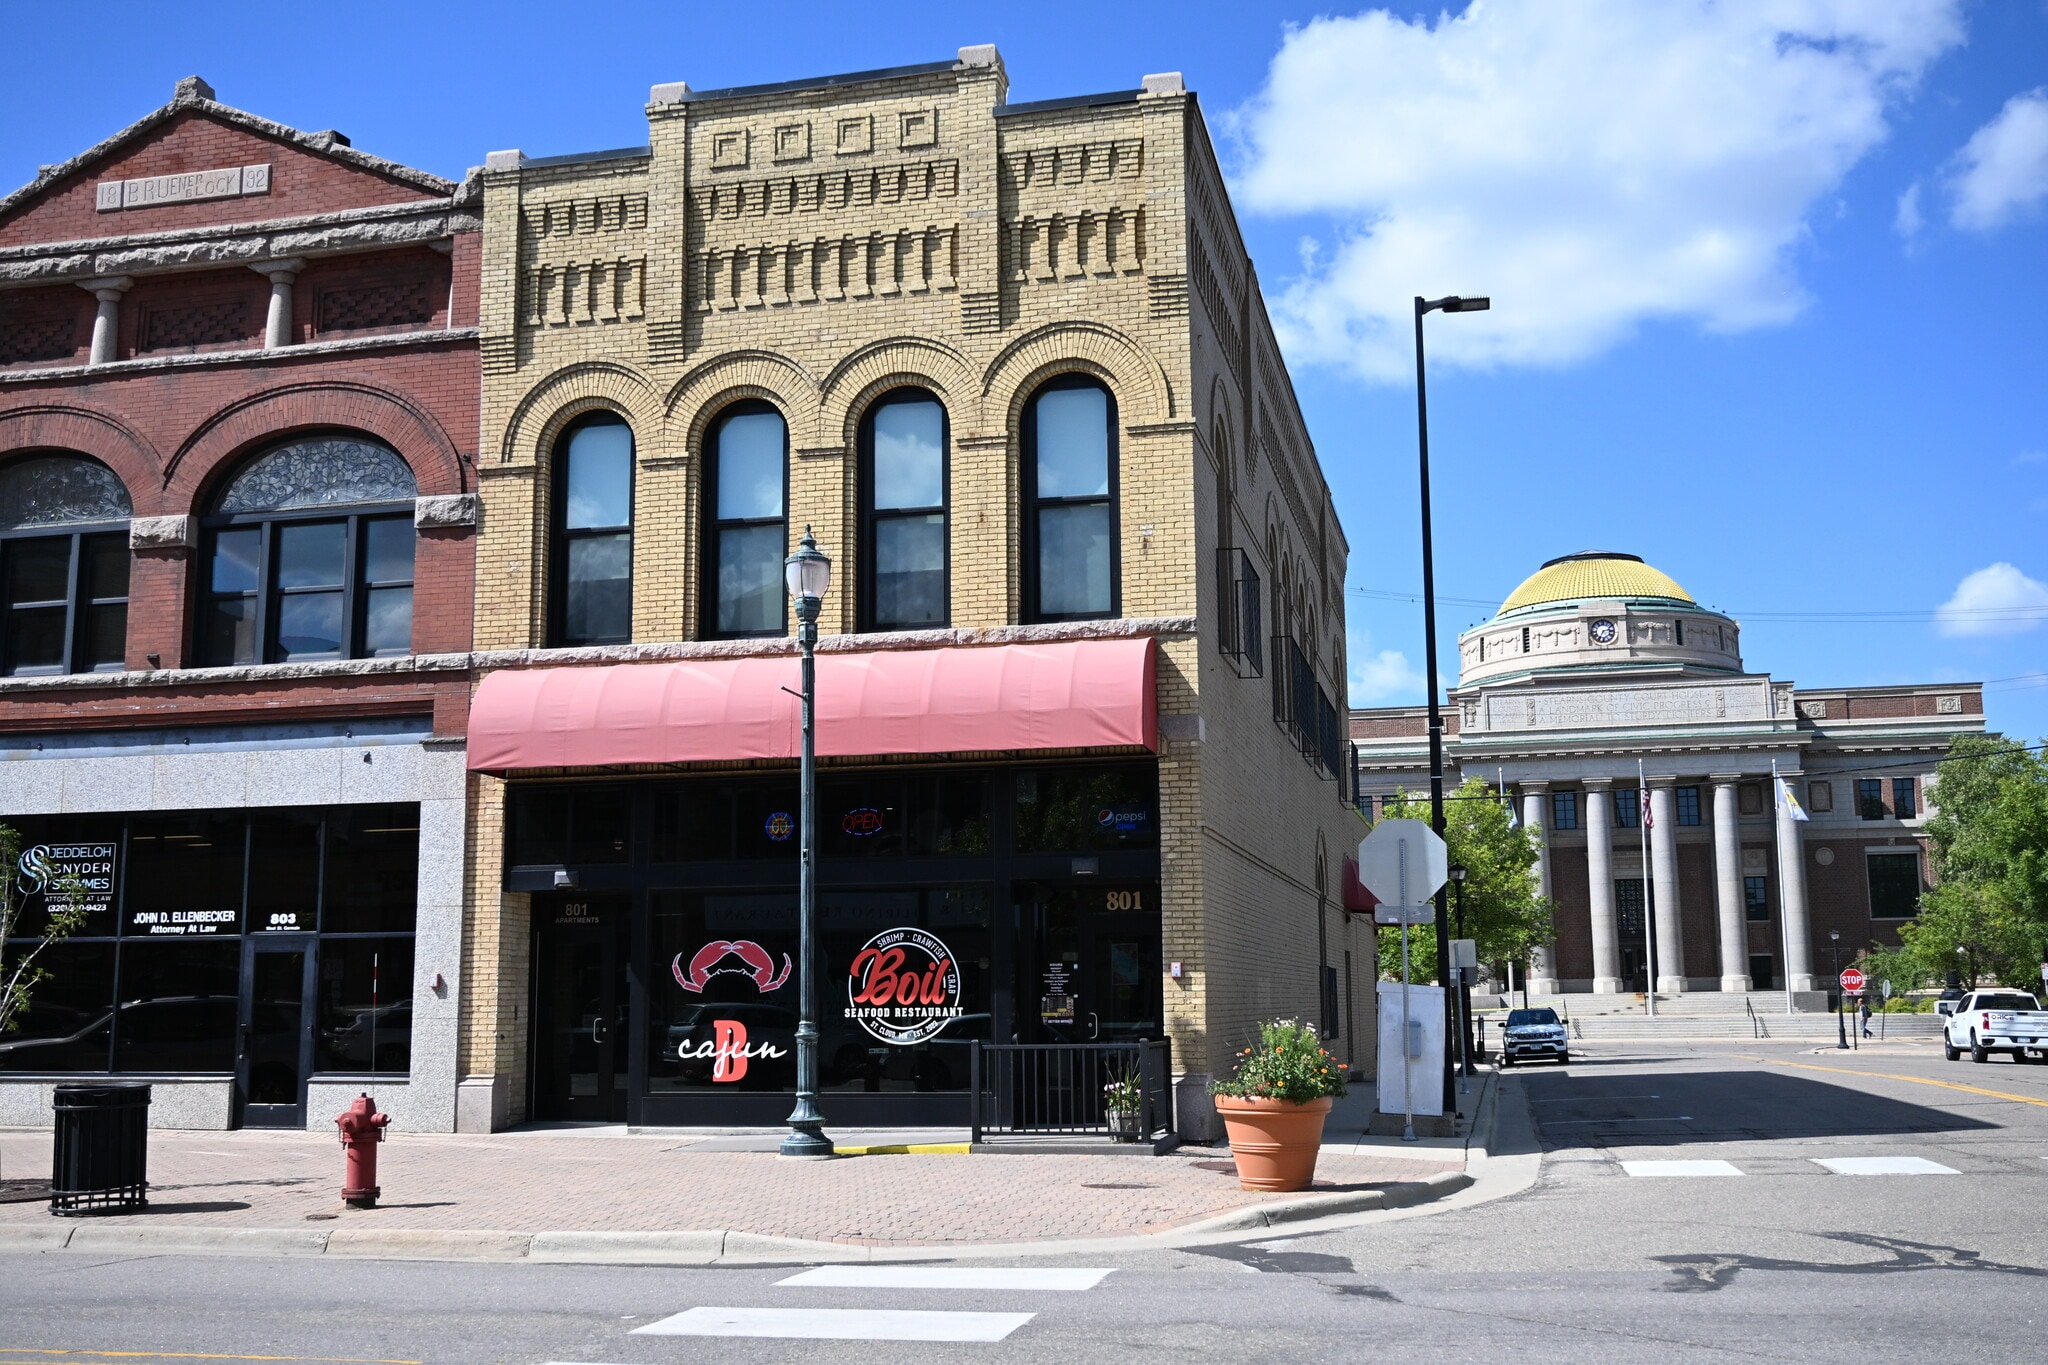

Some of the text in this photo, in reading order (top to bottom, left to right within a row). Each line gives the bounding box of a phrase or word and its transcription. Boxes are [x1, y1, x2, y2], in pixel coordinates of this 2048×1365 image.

[101, 169, 268, 205] 18 BRUENER BLOCK 92
[1544, 690, 1704, 705] STEARNS COUNTY COURT HOUSE
[1549, 704, 1603, 714] LANDMARK
[1607, 703, 1619, 712] OF
[1622, 702, 1650, 711] CIVIC
[1654, 700, 1703, 709] PROGRESS
[1549, 714, 1599, 723] MEMORIAL
[1607, 713, 1620, 721] TO
[1624, 711, 1661, 720] STURDY
[1666, 709, 1711, 719] PIONEERS
[842, 811, 884, 830] OPEN
[1115, 811, 1146, 823] pepsi
[49, 846, 112, 858] JEDDELOH
[53, 862, 111, 874] SNYDER
[1106, 891, 1142, 911] 801
[565, 903, 587, 916] 801
[134, 910, 236, 924] JOHN D. ELLENBECKER
[270, 913, 296, 925] 803
[555, 916, 600, 924] APARTMENTS
[150, 924, 217, 934] Attorney At Law
[876, 932, 956, 994] SHRIMP CRAWFISH CRAB
[850, 947, 951, 1006] Boil
[1841, 975, 1862, 985] STOP
[844, 1006, 964, 1018] SEAFOOD RESTAURANT
[870, 1020, 879, 1031] ST.
[913, 1028, 926, 1038] EST.
[678, 1028, 788, 1078] cajun
[712, 1019, 748, 1082] B
